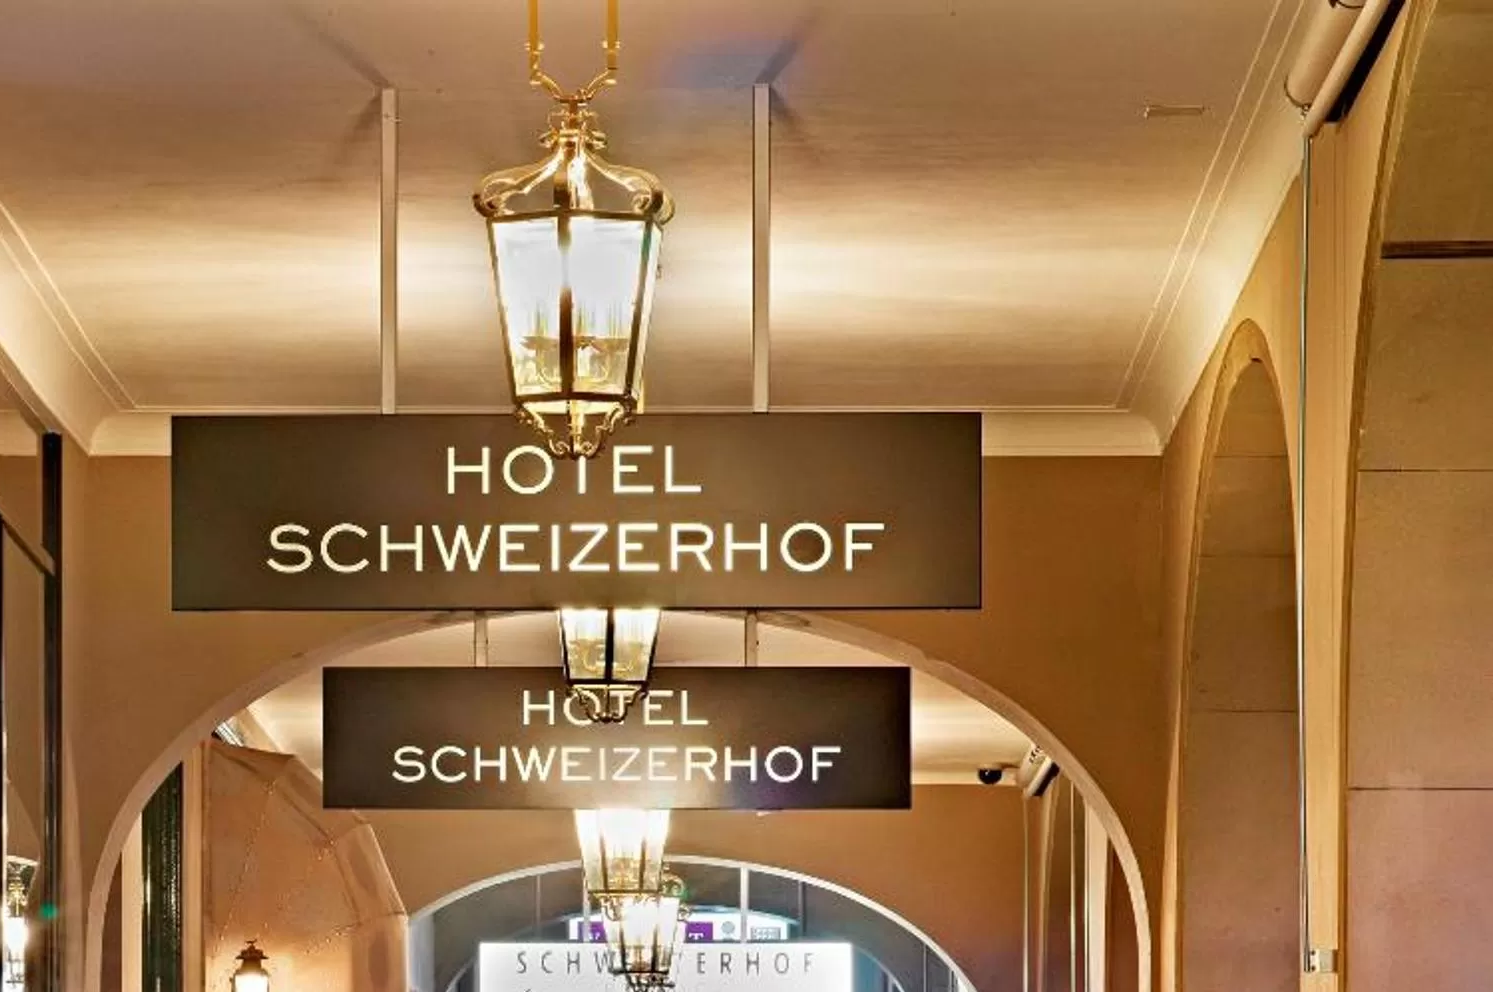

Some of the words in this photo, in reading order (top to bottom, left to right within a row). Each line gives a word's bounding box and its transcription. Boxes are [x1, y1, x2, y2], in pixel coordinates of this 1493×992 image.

[266, 523, 886, 573] SCHWEIZERHOF
[522, 690, 709, 726] HOTEL
[391, 745, 842, 783] SCHWEIZERHOF
[516, 951, 815, 976] SCHWERHOF
